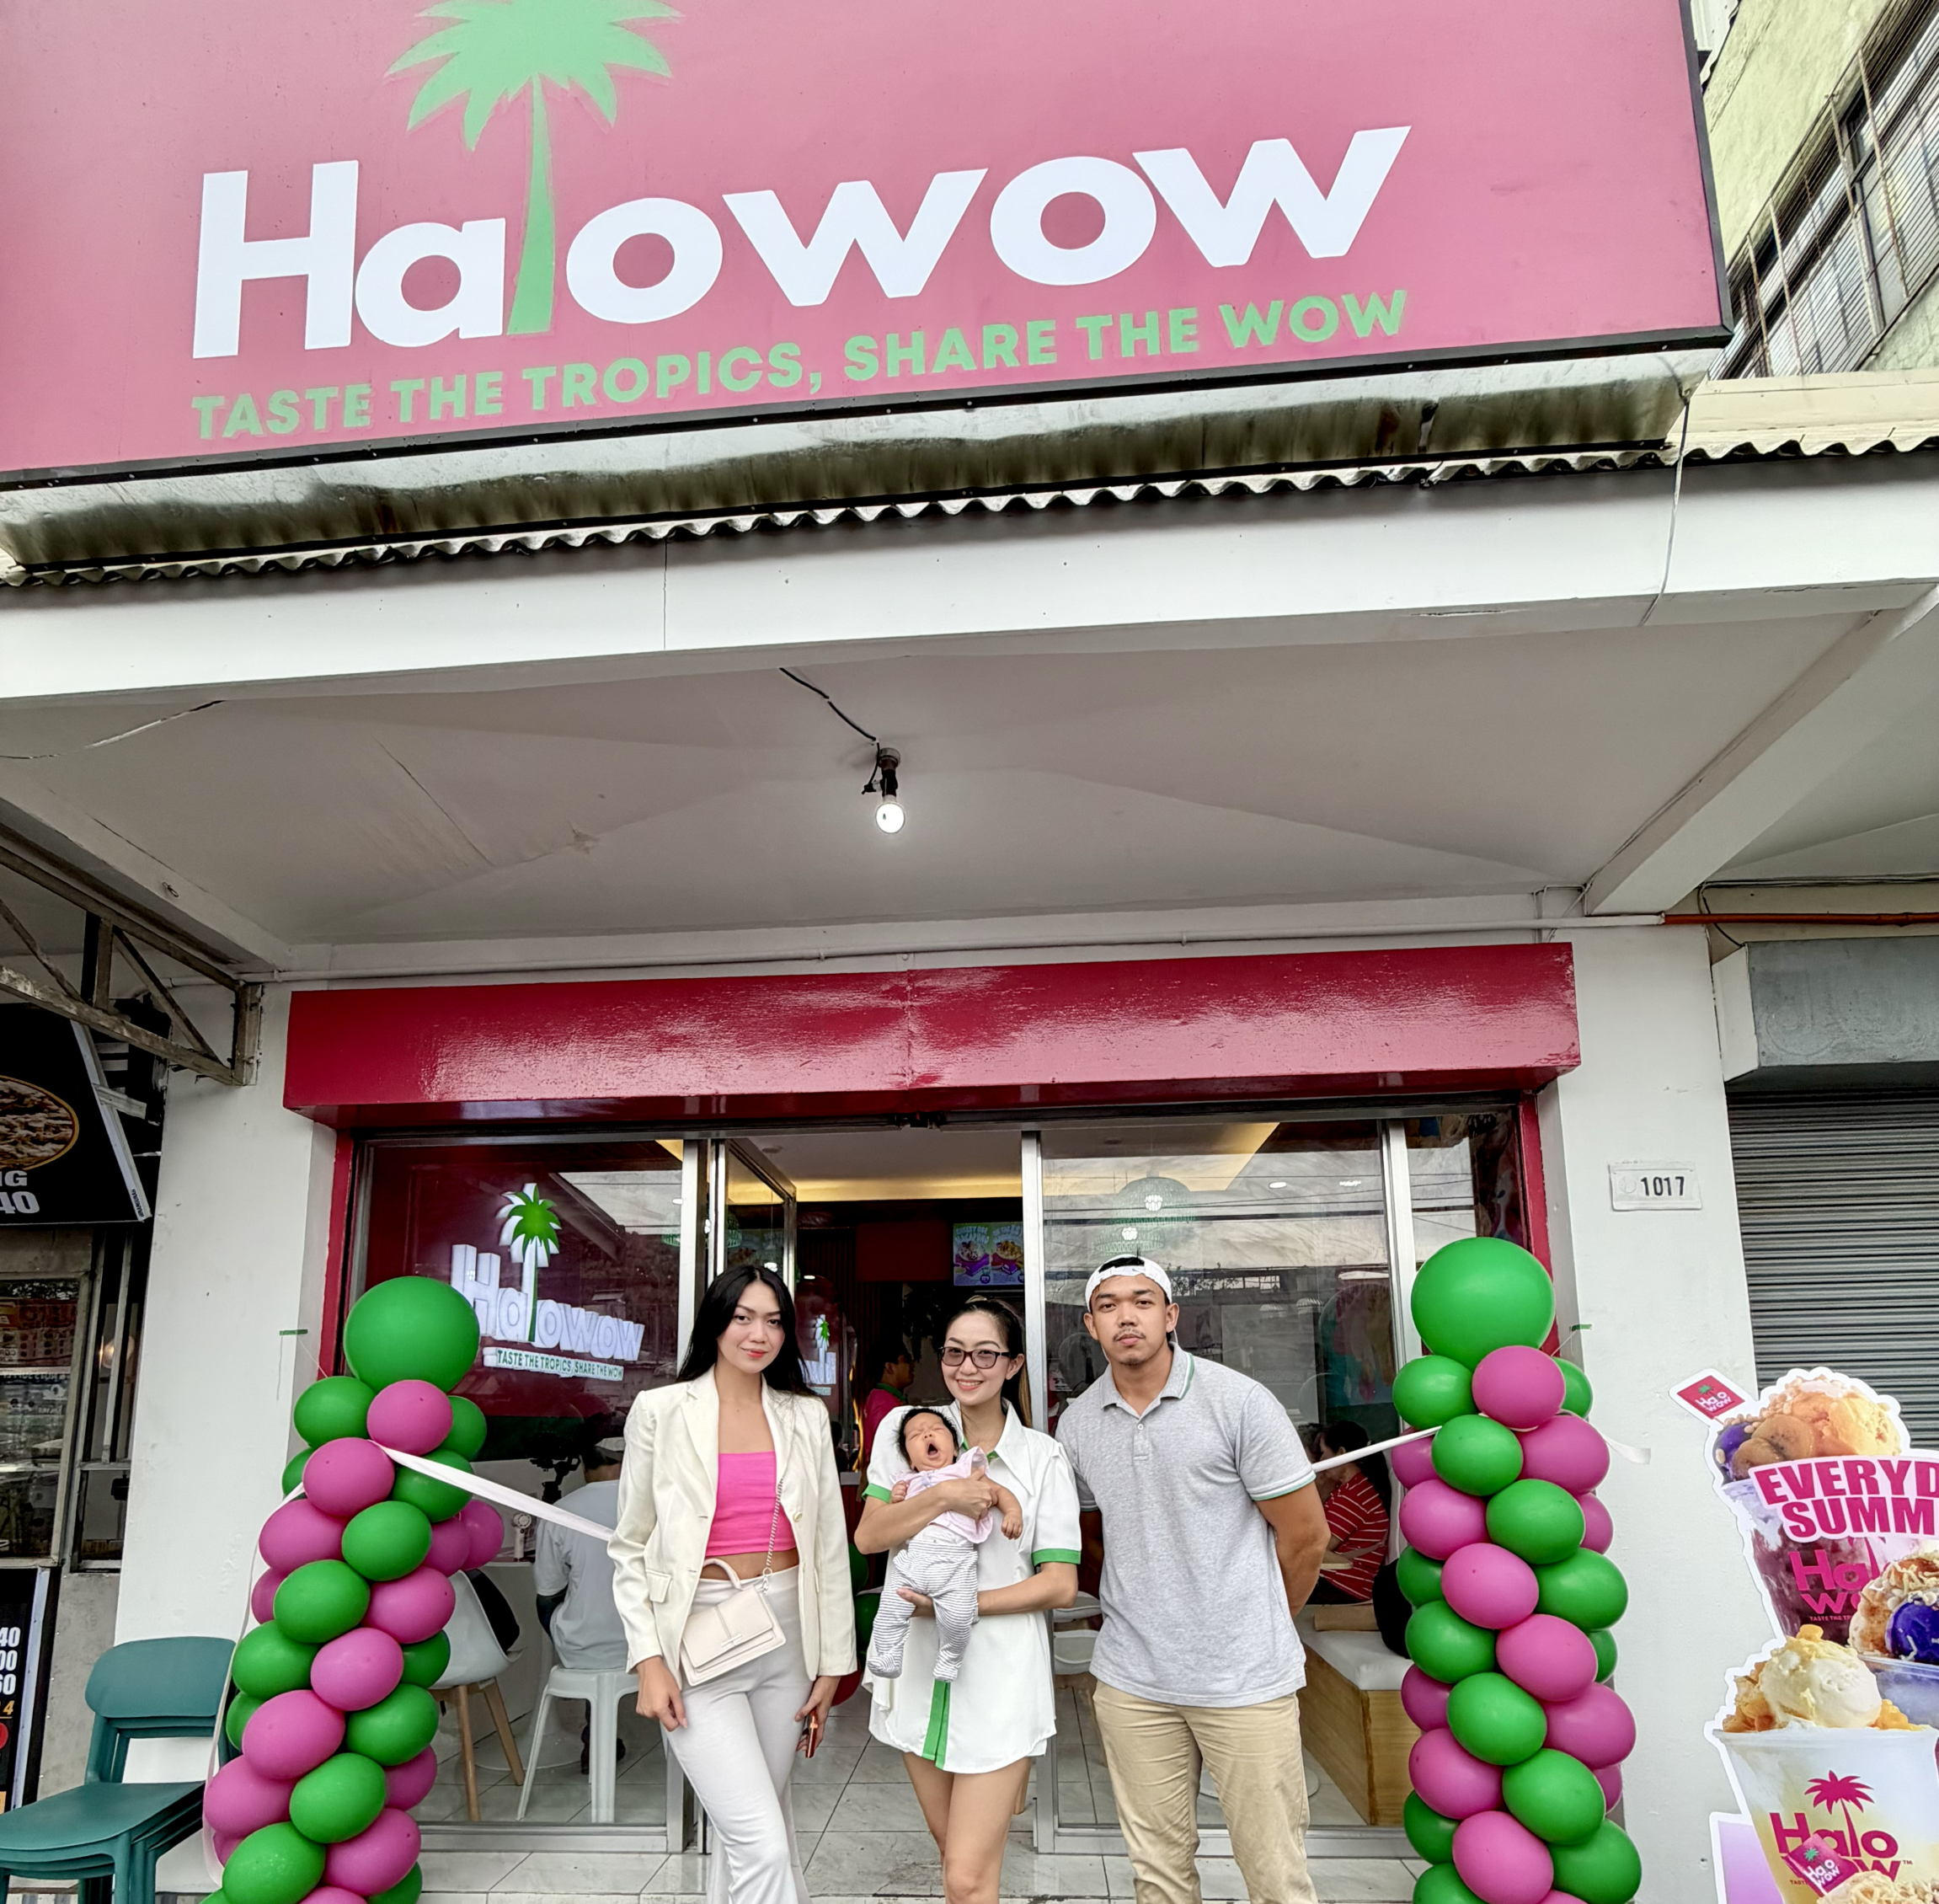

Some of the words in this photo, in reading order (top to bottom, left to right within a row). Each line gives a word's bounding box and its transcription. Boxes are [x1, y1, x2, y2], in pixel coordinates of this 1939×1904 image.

[193, 126, 1412, 360] Halowow
[193, 383, 372, 440] TASTE
[391, 372, 504, 423] THE
[522, 342, 823, 411] TROPICS,
[844, 319, 1059, 381] SHARE
[1076, 307, 1200, 361] THE
[1219, 289, 1408, 348] WOW
[0, 1170, 28, 1187] G
[1640, 1176, 1685, 1196] 1017
[451, 1244, 645, 1361] Halowow
[497, 1350, 523, 1366] TASTE
[524, 1354, 539, 1368] THE
[540, 1356, 574, 1374] TROPICS,
[574, 1361, 596, 1375] SHARE
[596, 1365, 607, 1377] THE
[607, 1366, 623, 1378] WOW
[1754, 1459, 1939, 1506] EVERYD
[1781, 1496, 1935, 1537] SUMM
